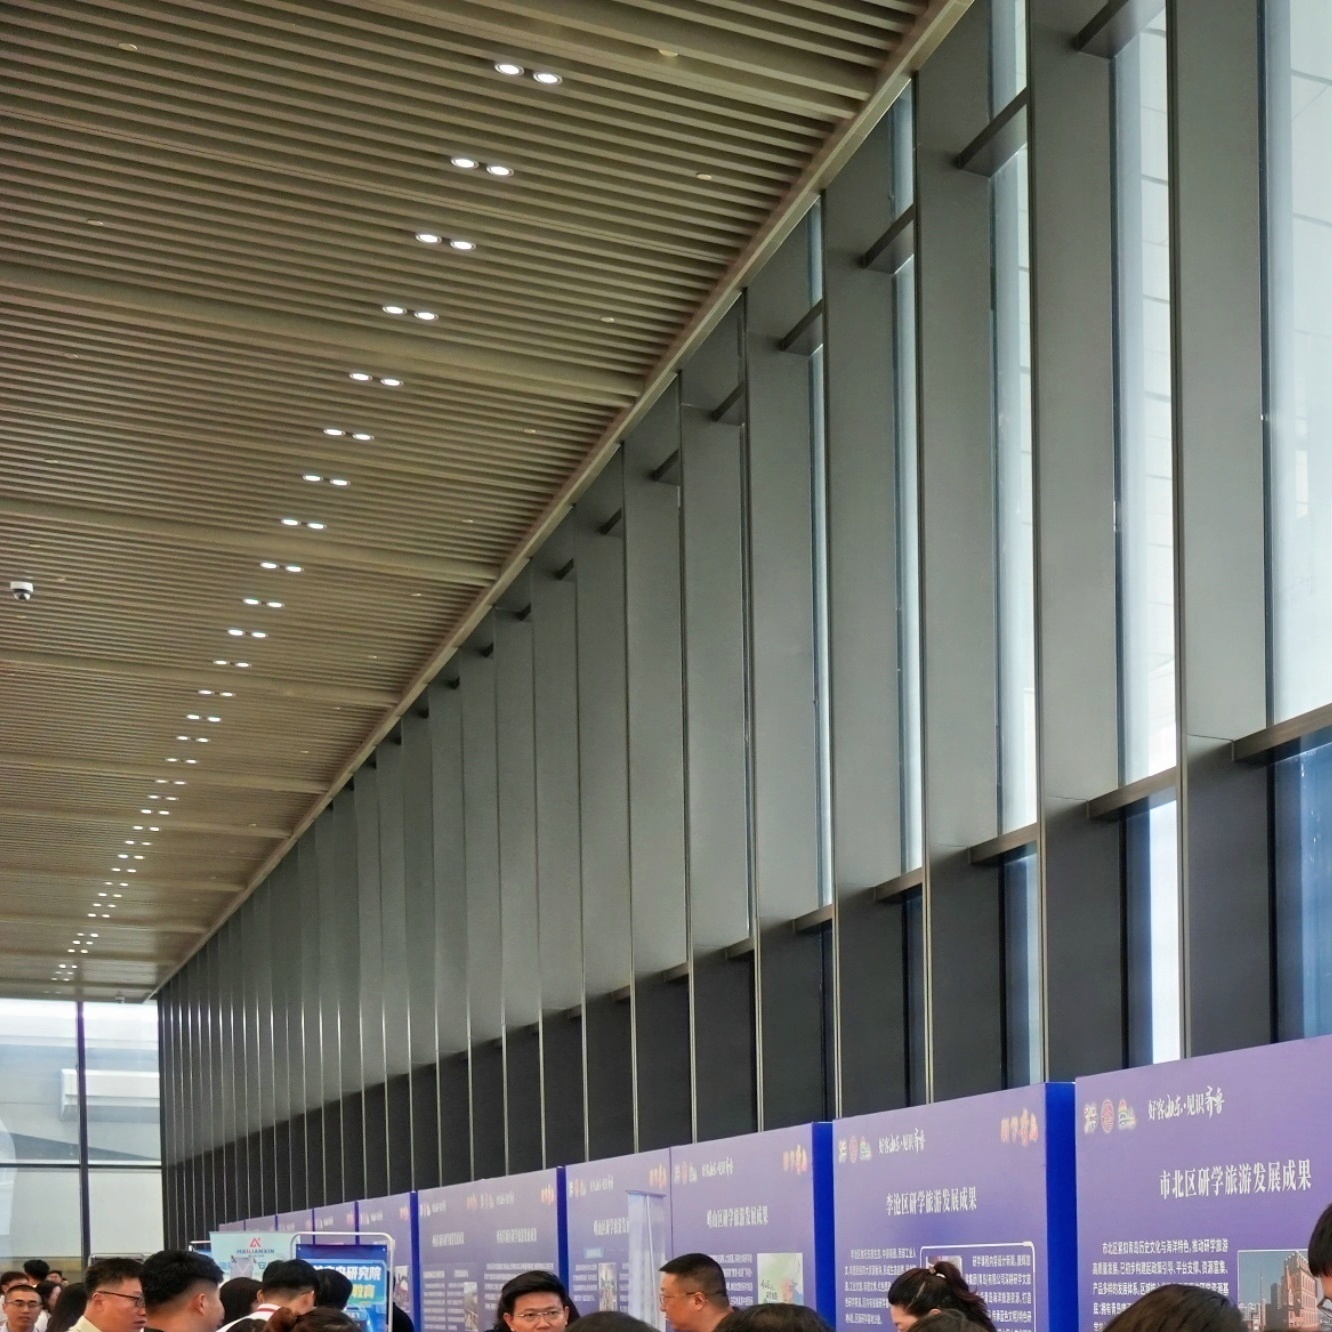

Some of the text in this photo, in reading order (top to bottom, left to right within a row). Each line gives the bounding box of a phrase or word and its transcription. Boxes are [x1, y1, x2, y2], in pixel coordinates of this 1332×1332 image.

[1159, 1158, 1312, 1199] 市北区研学旅游发展成果
